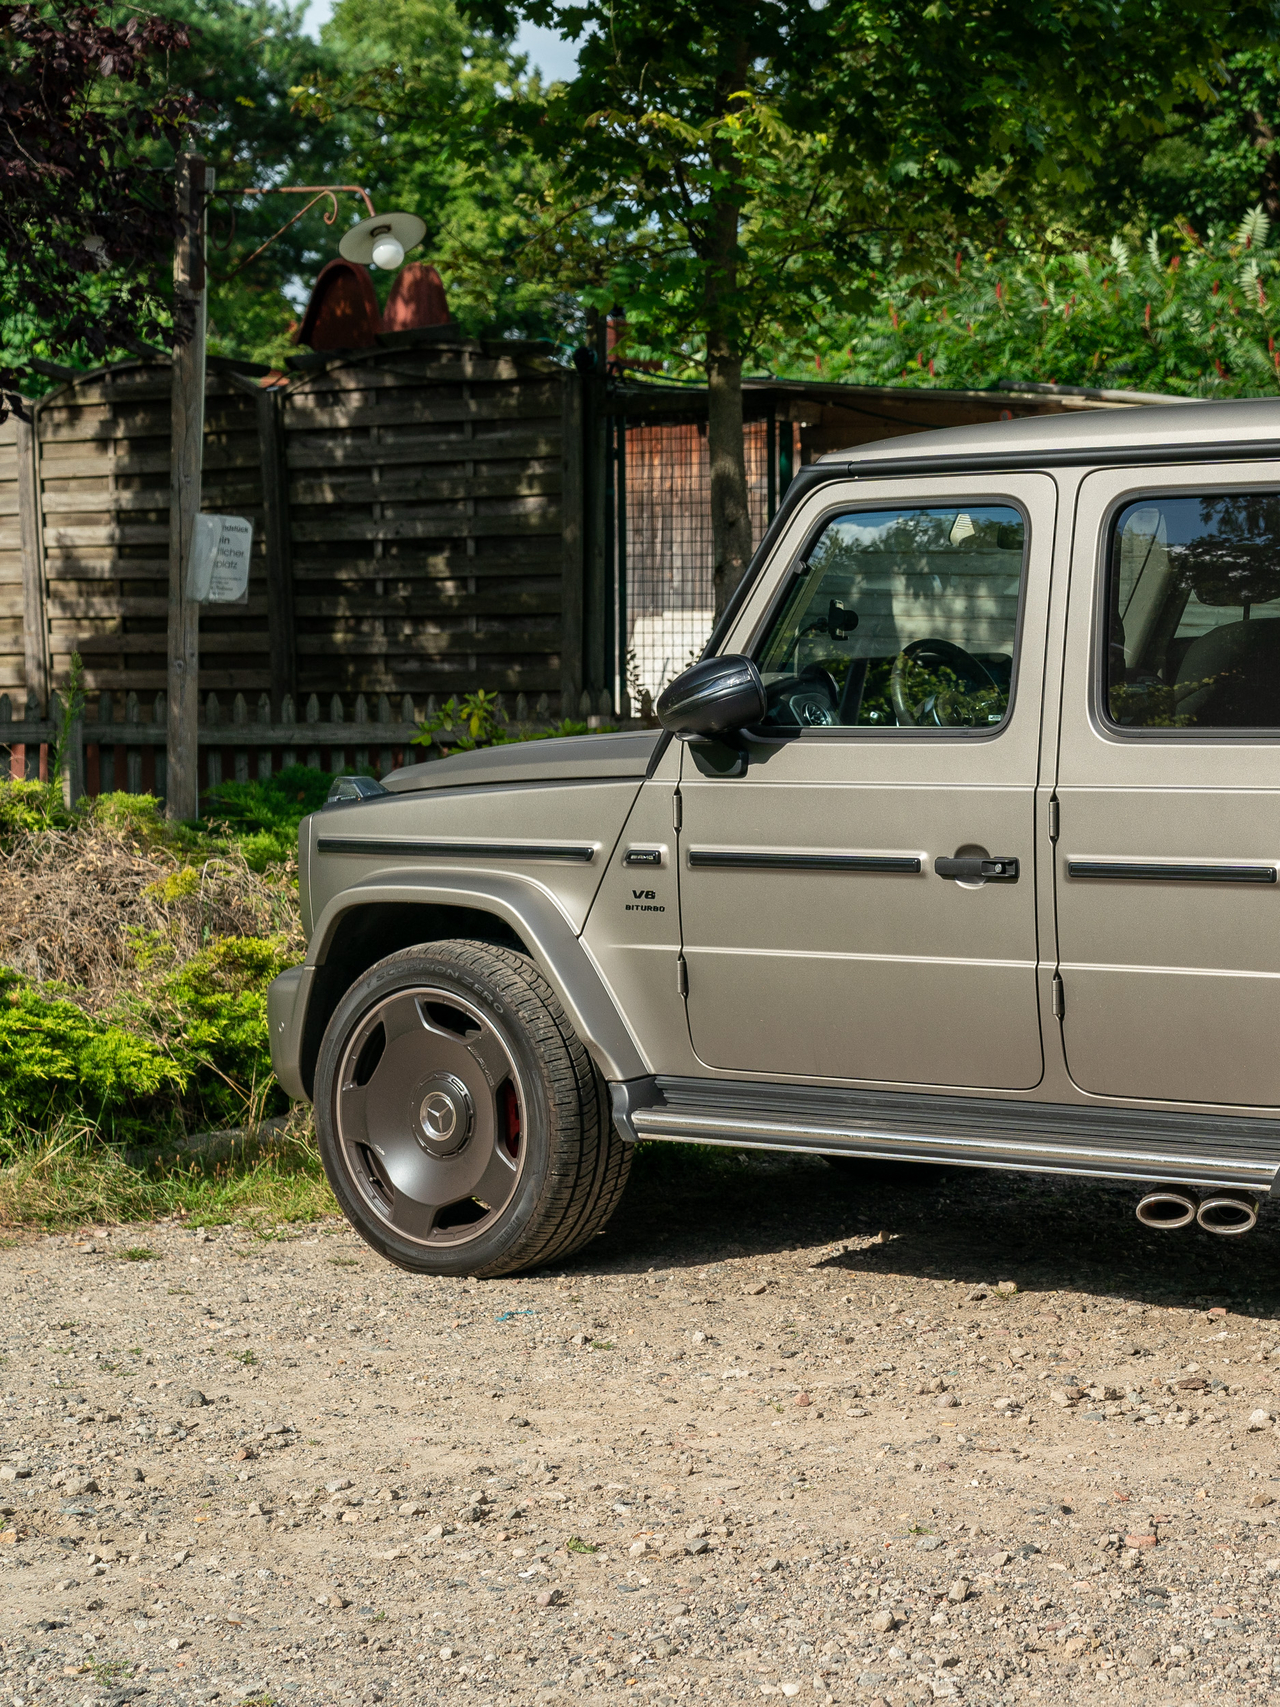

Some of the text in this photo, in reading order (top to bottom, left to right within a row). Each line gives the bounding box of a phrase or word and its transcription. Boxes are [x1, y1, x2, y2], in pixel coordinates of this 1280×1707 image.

[222, 525, 248, 533] ndstück
[219, 534, 230, 544] in
[214, 559, 238, 570] platz
[632, 889, 656, 900] V8
[625, 904, 665, 913] BITURBO
